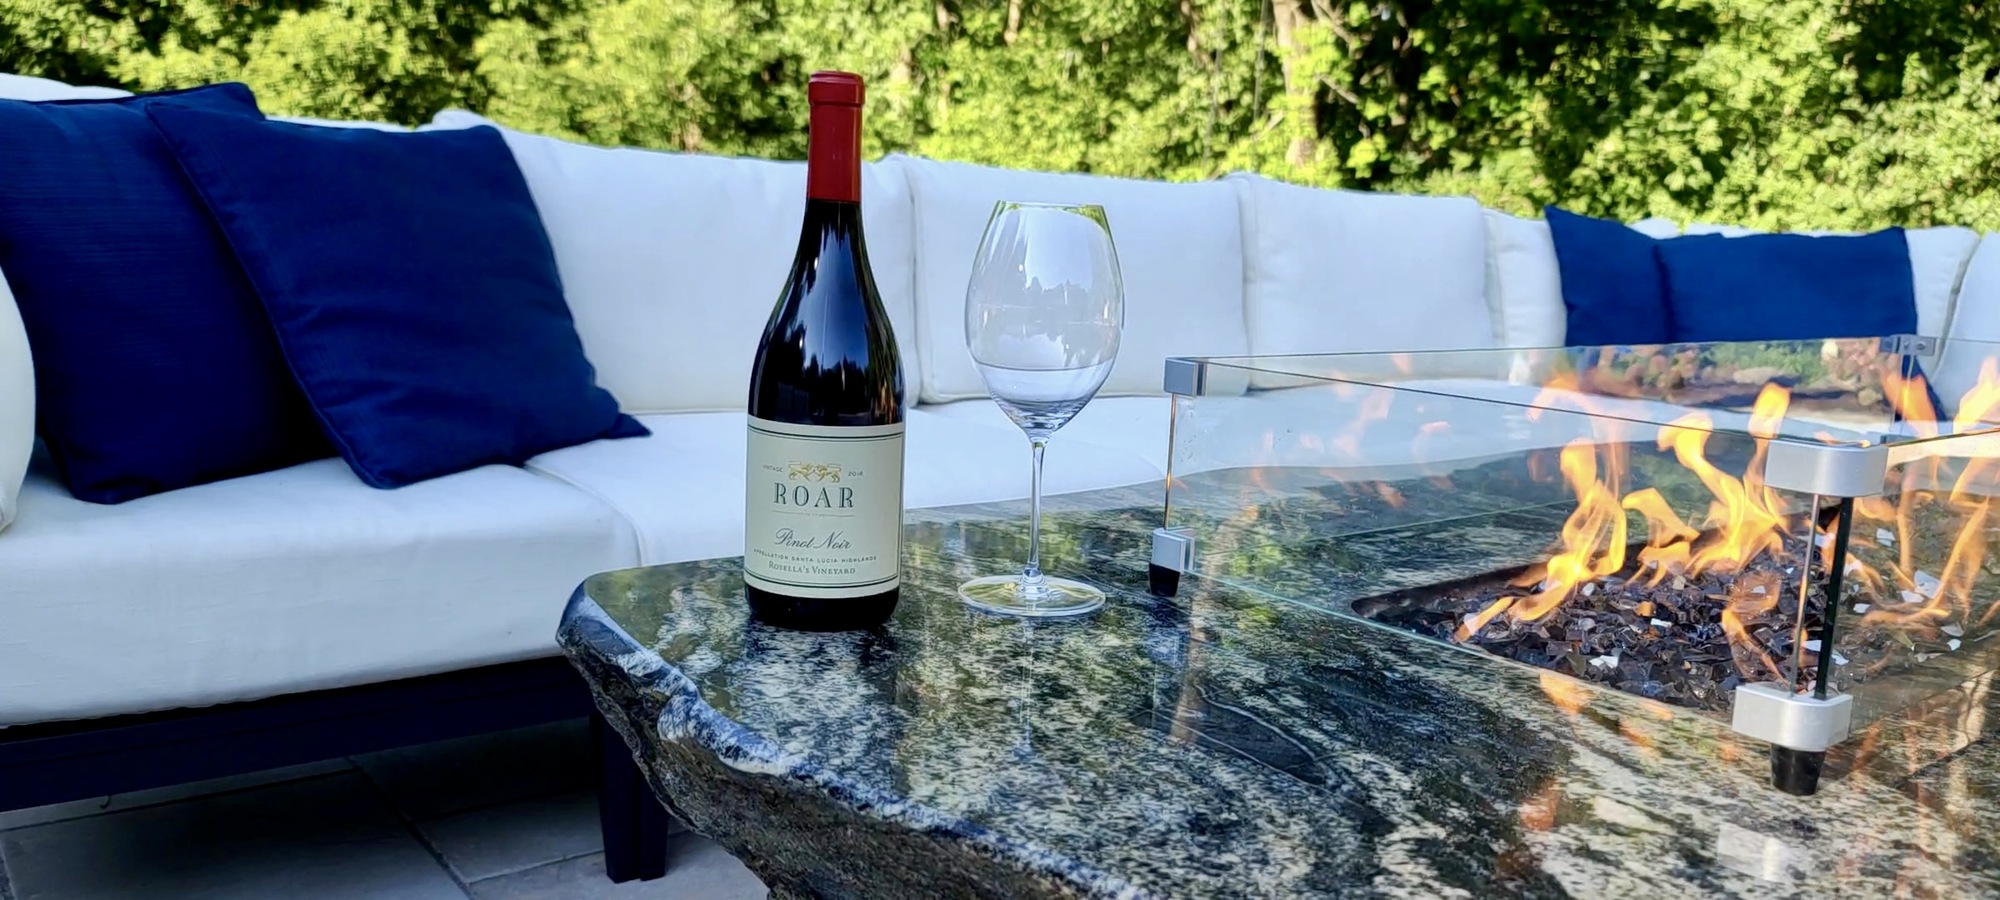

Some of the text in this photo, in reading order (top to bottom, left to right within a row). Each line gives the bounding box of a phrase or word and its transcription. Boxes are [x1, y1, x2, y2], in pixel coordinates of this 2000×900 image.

[763, 464, 784, 473] VINTAGE
[773, 482, 853, 508] ROAR
[774, 527, 851, 549] Pinot Noir
[753, 548, 789, 560] APPELLATION
[841, 555, 877, 563] HIGHLANDS
[768, 561, 856, 575] ROSELLA'S VINEYARD
